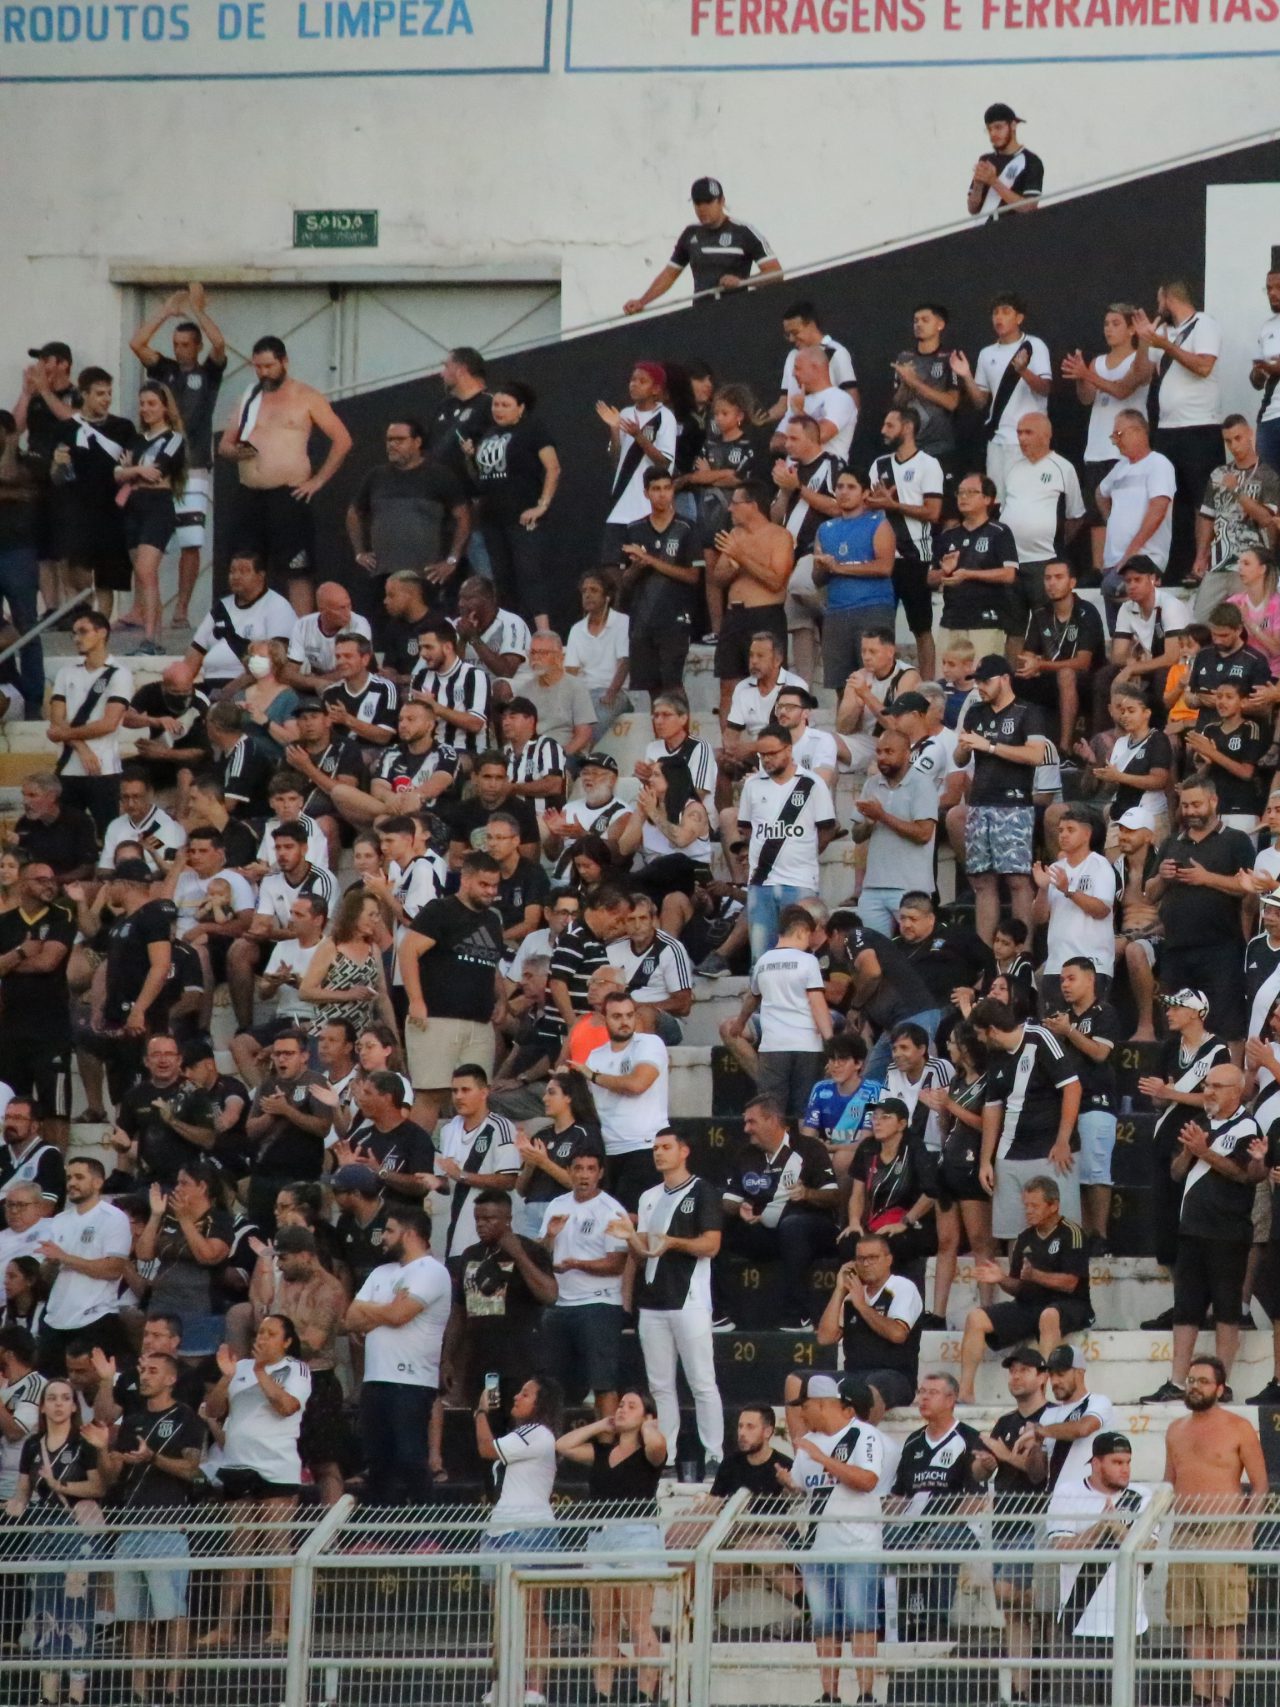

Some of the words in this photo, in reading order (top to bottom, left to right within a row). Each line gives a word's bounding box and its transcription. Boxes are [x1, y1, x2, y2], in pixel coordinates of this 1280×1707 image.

[4, 4, 189, 42] RODUTOS
[218, 3, 265, 40] DE
[298, 0, 474, 38] LIMPEZA
[690, 0, 926, 36] FERRAGENS
[944, 0, 962, 30] E
[756, 821, 805, 840] Philco
[1122, 1048, 1140, 1069] 21
[708, 1126, 725, 1148] 16
[745, 1176, 769, 1187] EMS
[742, 1267, 760, 1289] 19
[733, 1342, 755, 1362] 20
[794, 1342, 815, 1366] 21
[1151, 1341, 1170, 1361] 26
[1129, 1414, 1150, 1434] 27
[914, 1471, 947, 1483] HITACHI
